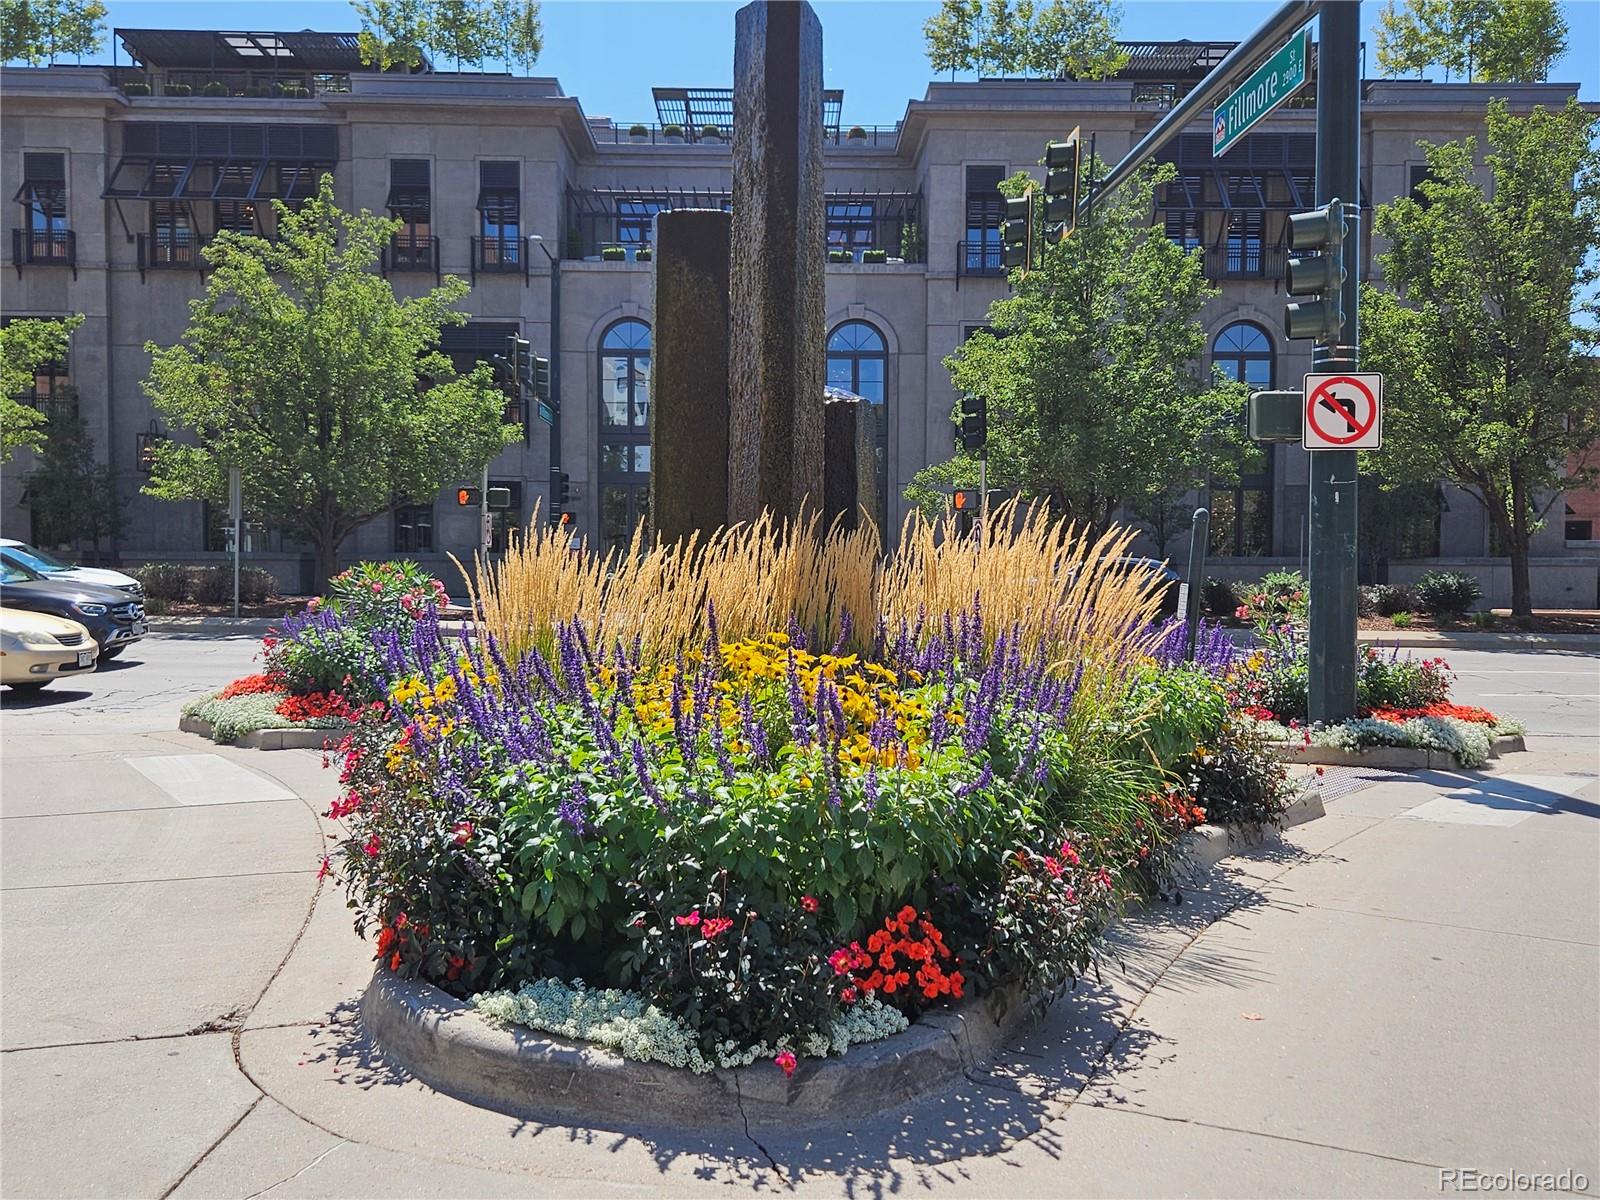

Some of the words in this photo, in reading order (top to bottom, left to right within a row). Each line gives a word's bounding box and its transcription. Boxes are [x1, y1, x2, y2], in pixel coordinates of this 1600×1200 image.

[1298, 58, 1303, 73] E
[1228, 71, 1278, 135] Fillmore
[1289, 48, 1296, 64] St
